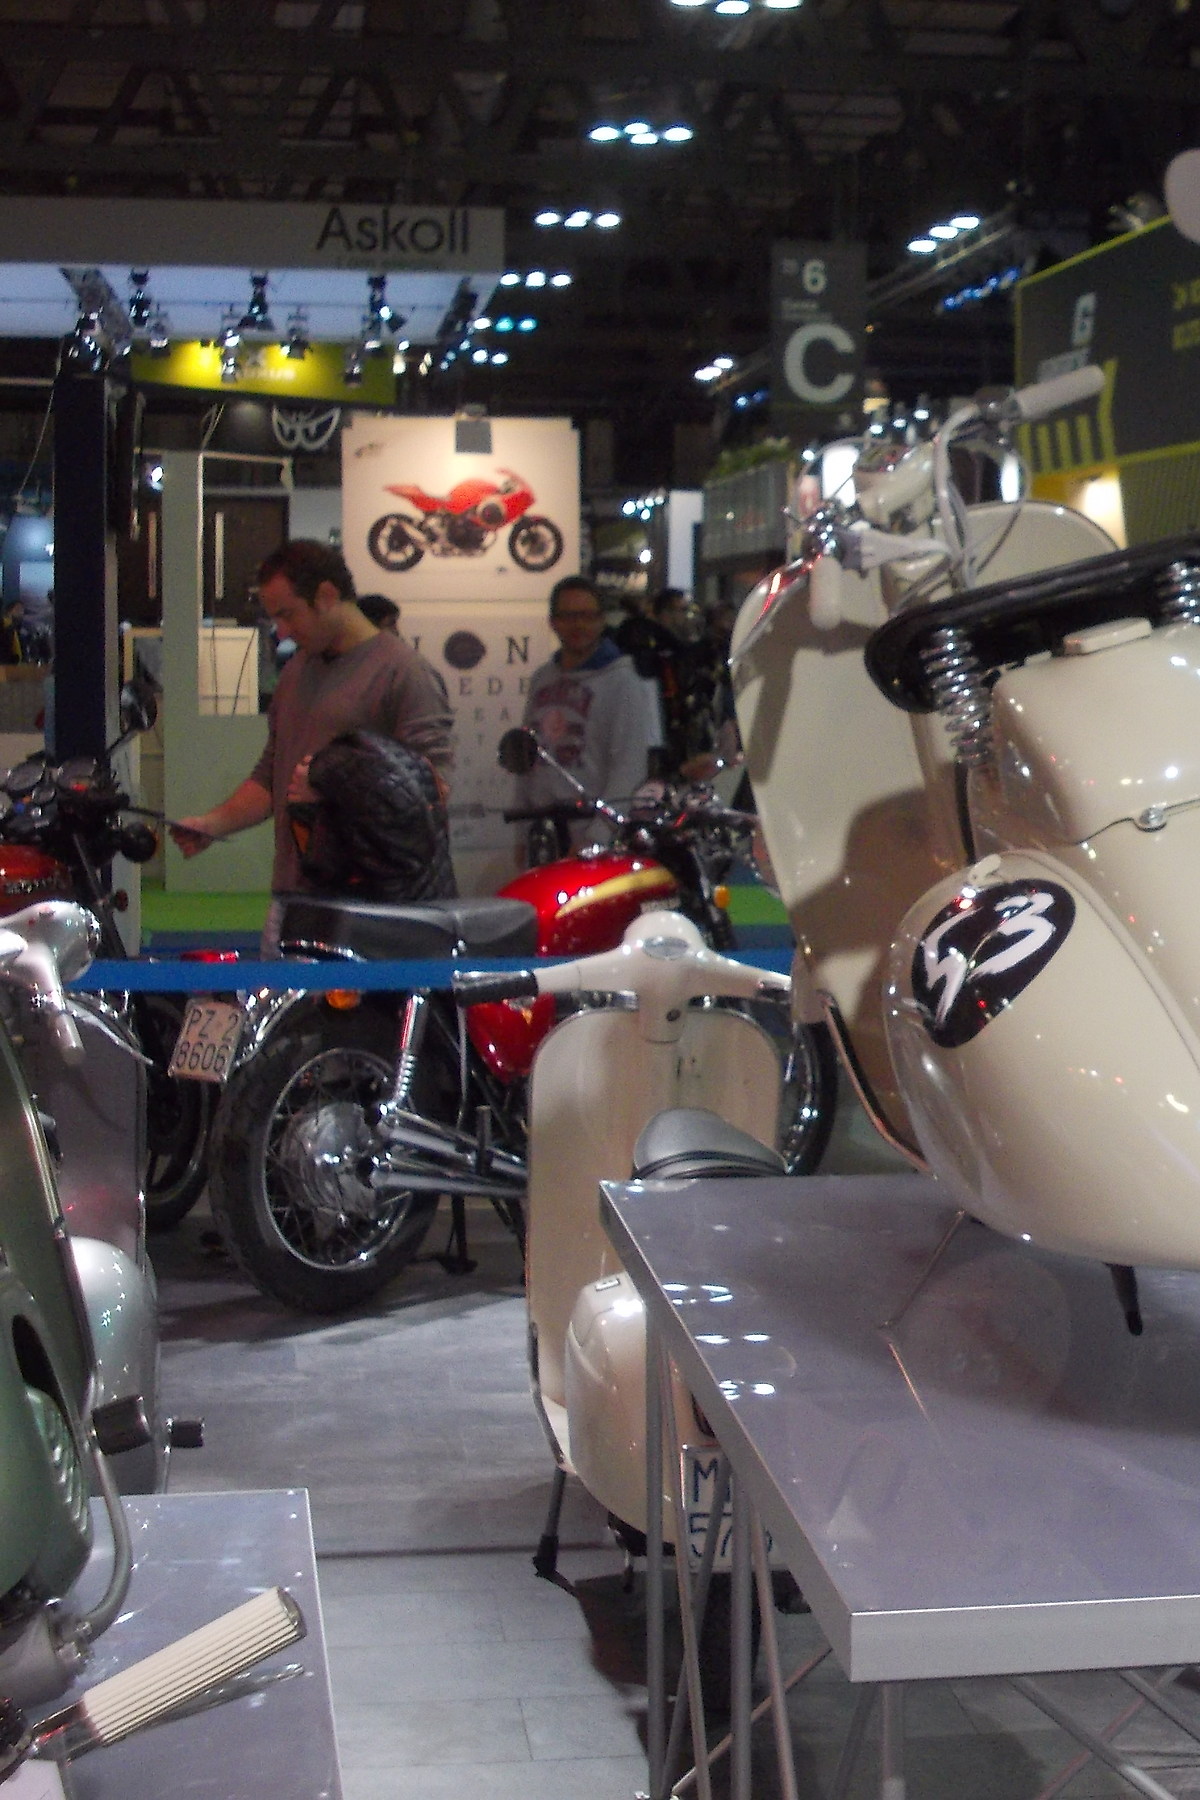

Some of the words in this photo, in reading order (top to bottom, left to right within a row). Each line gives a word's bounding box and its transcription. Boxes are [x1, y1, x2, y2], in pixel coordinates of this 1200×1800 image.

[316, 197, 469, 254] Askoll
[802, 259, 828, 295] 6
[784, 322, 856, 403] C
[923, 892, 1056, 1032] 53
[186, 1008, 217, 1039] PZ
[221, 1012, 239, 1042] 2
[176, 1041, 230, 1072] 8606
